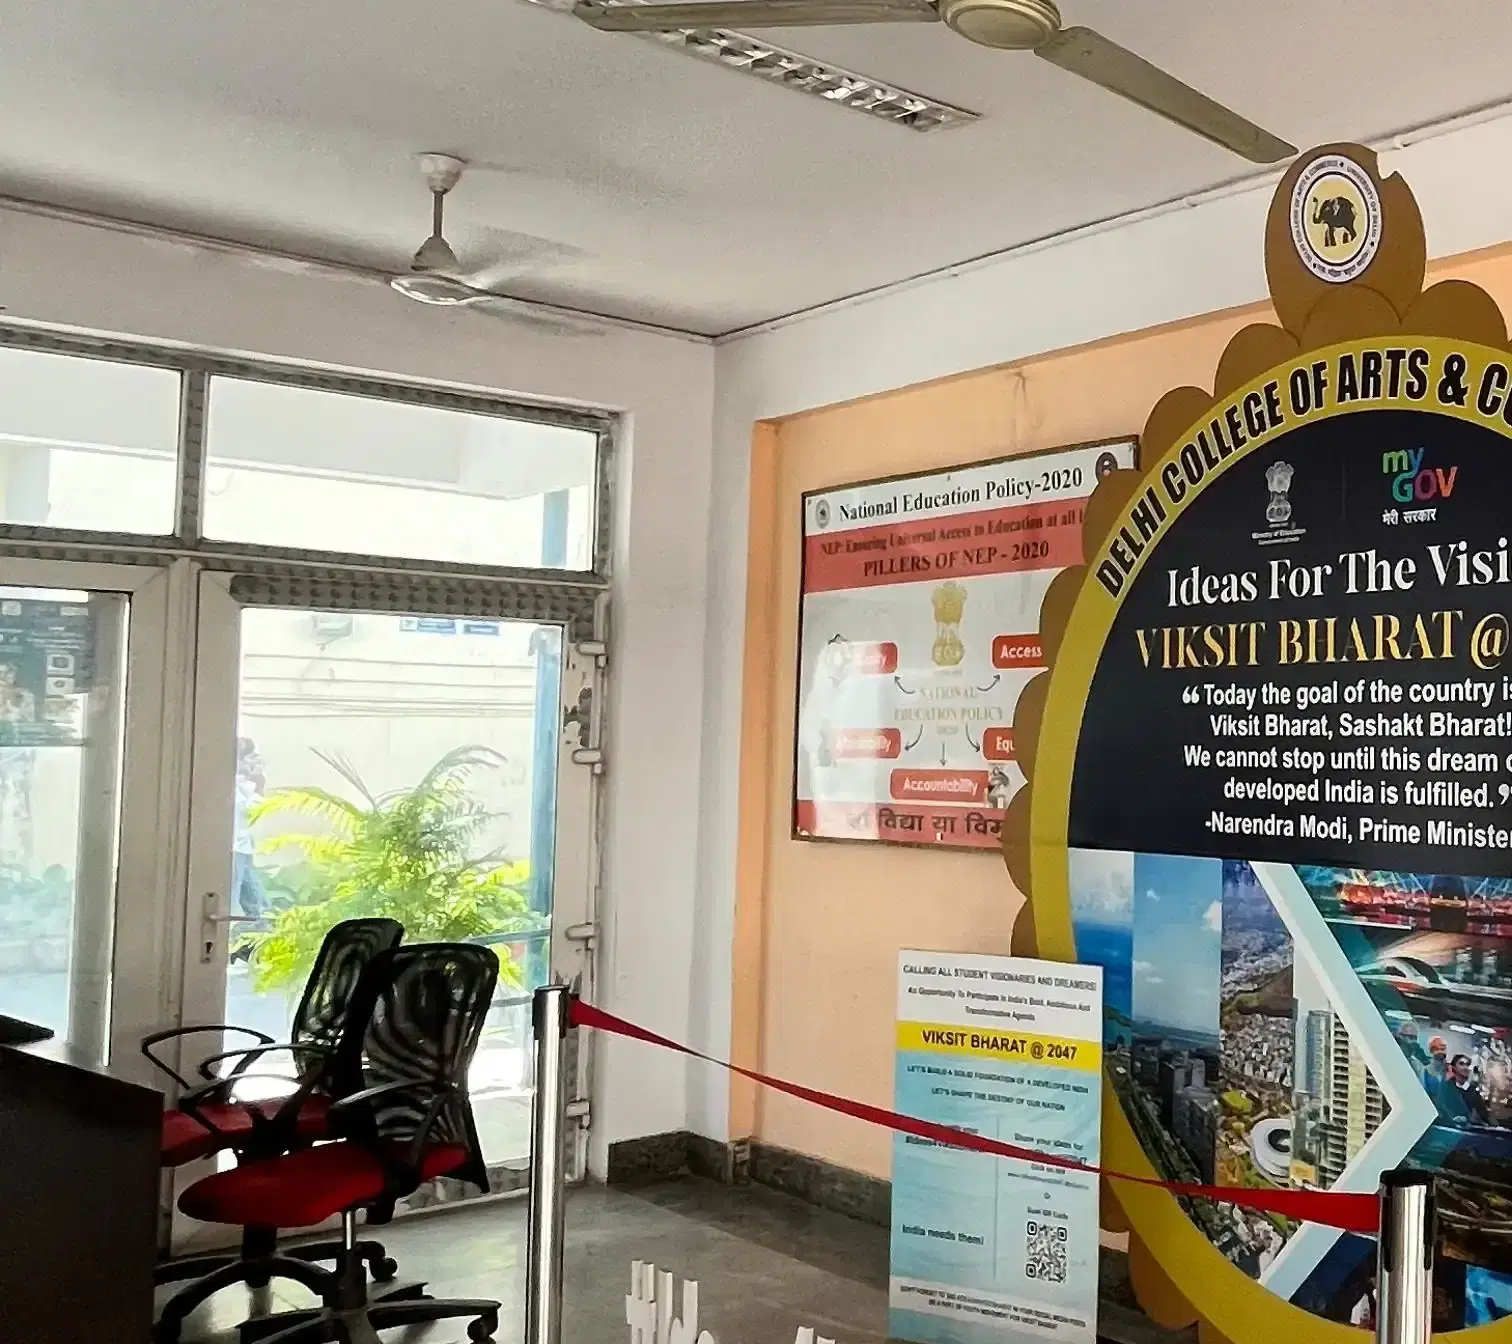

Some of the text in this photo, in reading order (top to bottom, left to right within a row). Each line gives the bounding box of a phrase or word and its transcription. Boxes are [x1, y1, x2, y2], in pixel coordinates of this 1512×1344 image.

[1096, 486, 1168, 598] DELHI
[1161, 381, 1284, 505] COLLEGE
[1289, 360, 1328, 416] OF
[1336, 348, 1429, 404] ARTS
[1437, 352, 1469, 407] &
[840, 496, 897, 521] National
[903, 487, 979, 512] Education
[987, 468, 1082, 500] Policy-2020
[1382, 508, 1437, 525] मेरी सरकार
[864, 554, 931, 577] PILLERS
[935, 551, 956, 569] OF
[962, 547, 997, 566] NEP
[1012, 540, 1048, 561] 2020
[1168, 566, 1257, 607] Ideas
[1269, 559, 1332, 599] For
[1339, 549, 1416, 593] The
[1136, 622, 1266, 669] VIKSIT
[1278, 611, 1463, 665] BHARAT
[1262, 682, 1290, 704] the
[1297, 681, 1337, 709] goal
[1344, 680, 1365, 703] of
[1370, 679, 1402, 702] the
[1409, 678, 1495, 707] country
[1210, 712, 1511, 740] Viksit Bharat, Sashakt Bharat!
[1184, 745, 1210, 766] We
[1216, 747, 1277, 768] cannot
[1283, 747, 1324, 774] stop
[1331, 747, 1374, 770] until
[1381, 747, 1420, 771] this
[1428, 747, 1498, 772] dream
[1224, 777, 1319, 806] developed
[1325, 779, 1373, 803] India
[1381, 781, 1398, 804] is
[1205, 811, 1293, 836] -Narendra
[1300, 815, 1352, 844] Modi,
[1360, 818, 1420, 843] Prime
[923, 1029, 1077, 1060] VIKSIT BHARAT @ 2047
